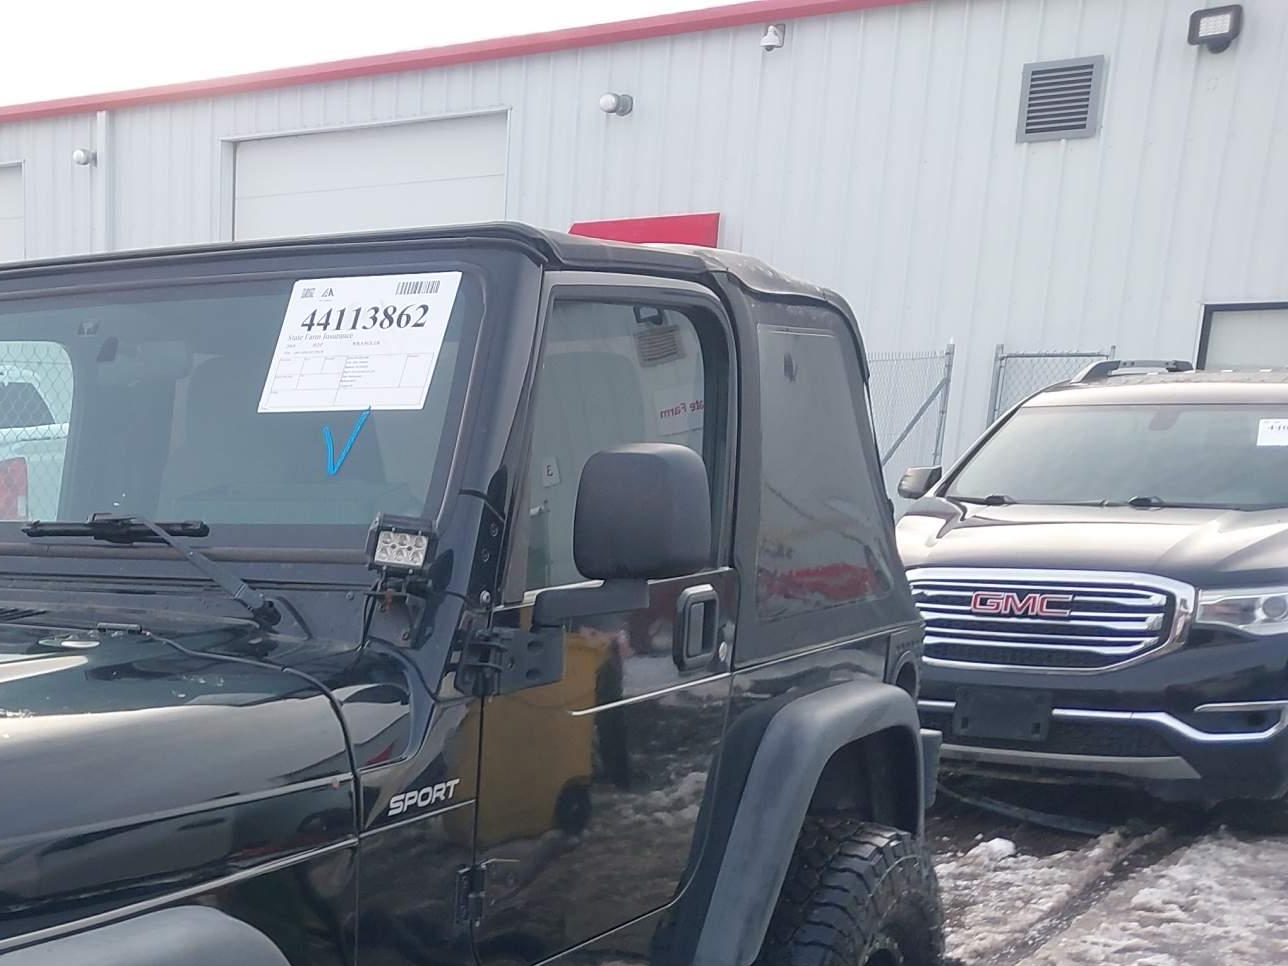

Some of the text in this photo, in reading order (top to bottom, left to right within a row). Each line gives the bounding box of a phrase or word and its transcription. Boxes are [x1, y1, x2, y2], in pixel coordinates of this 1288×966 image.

[300, 303, 429, 332] 44113862
[971, 590, 1073, 617] GMC
[387, 778, 460, 817] SPORT
